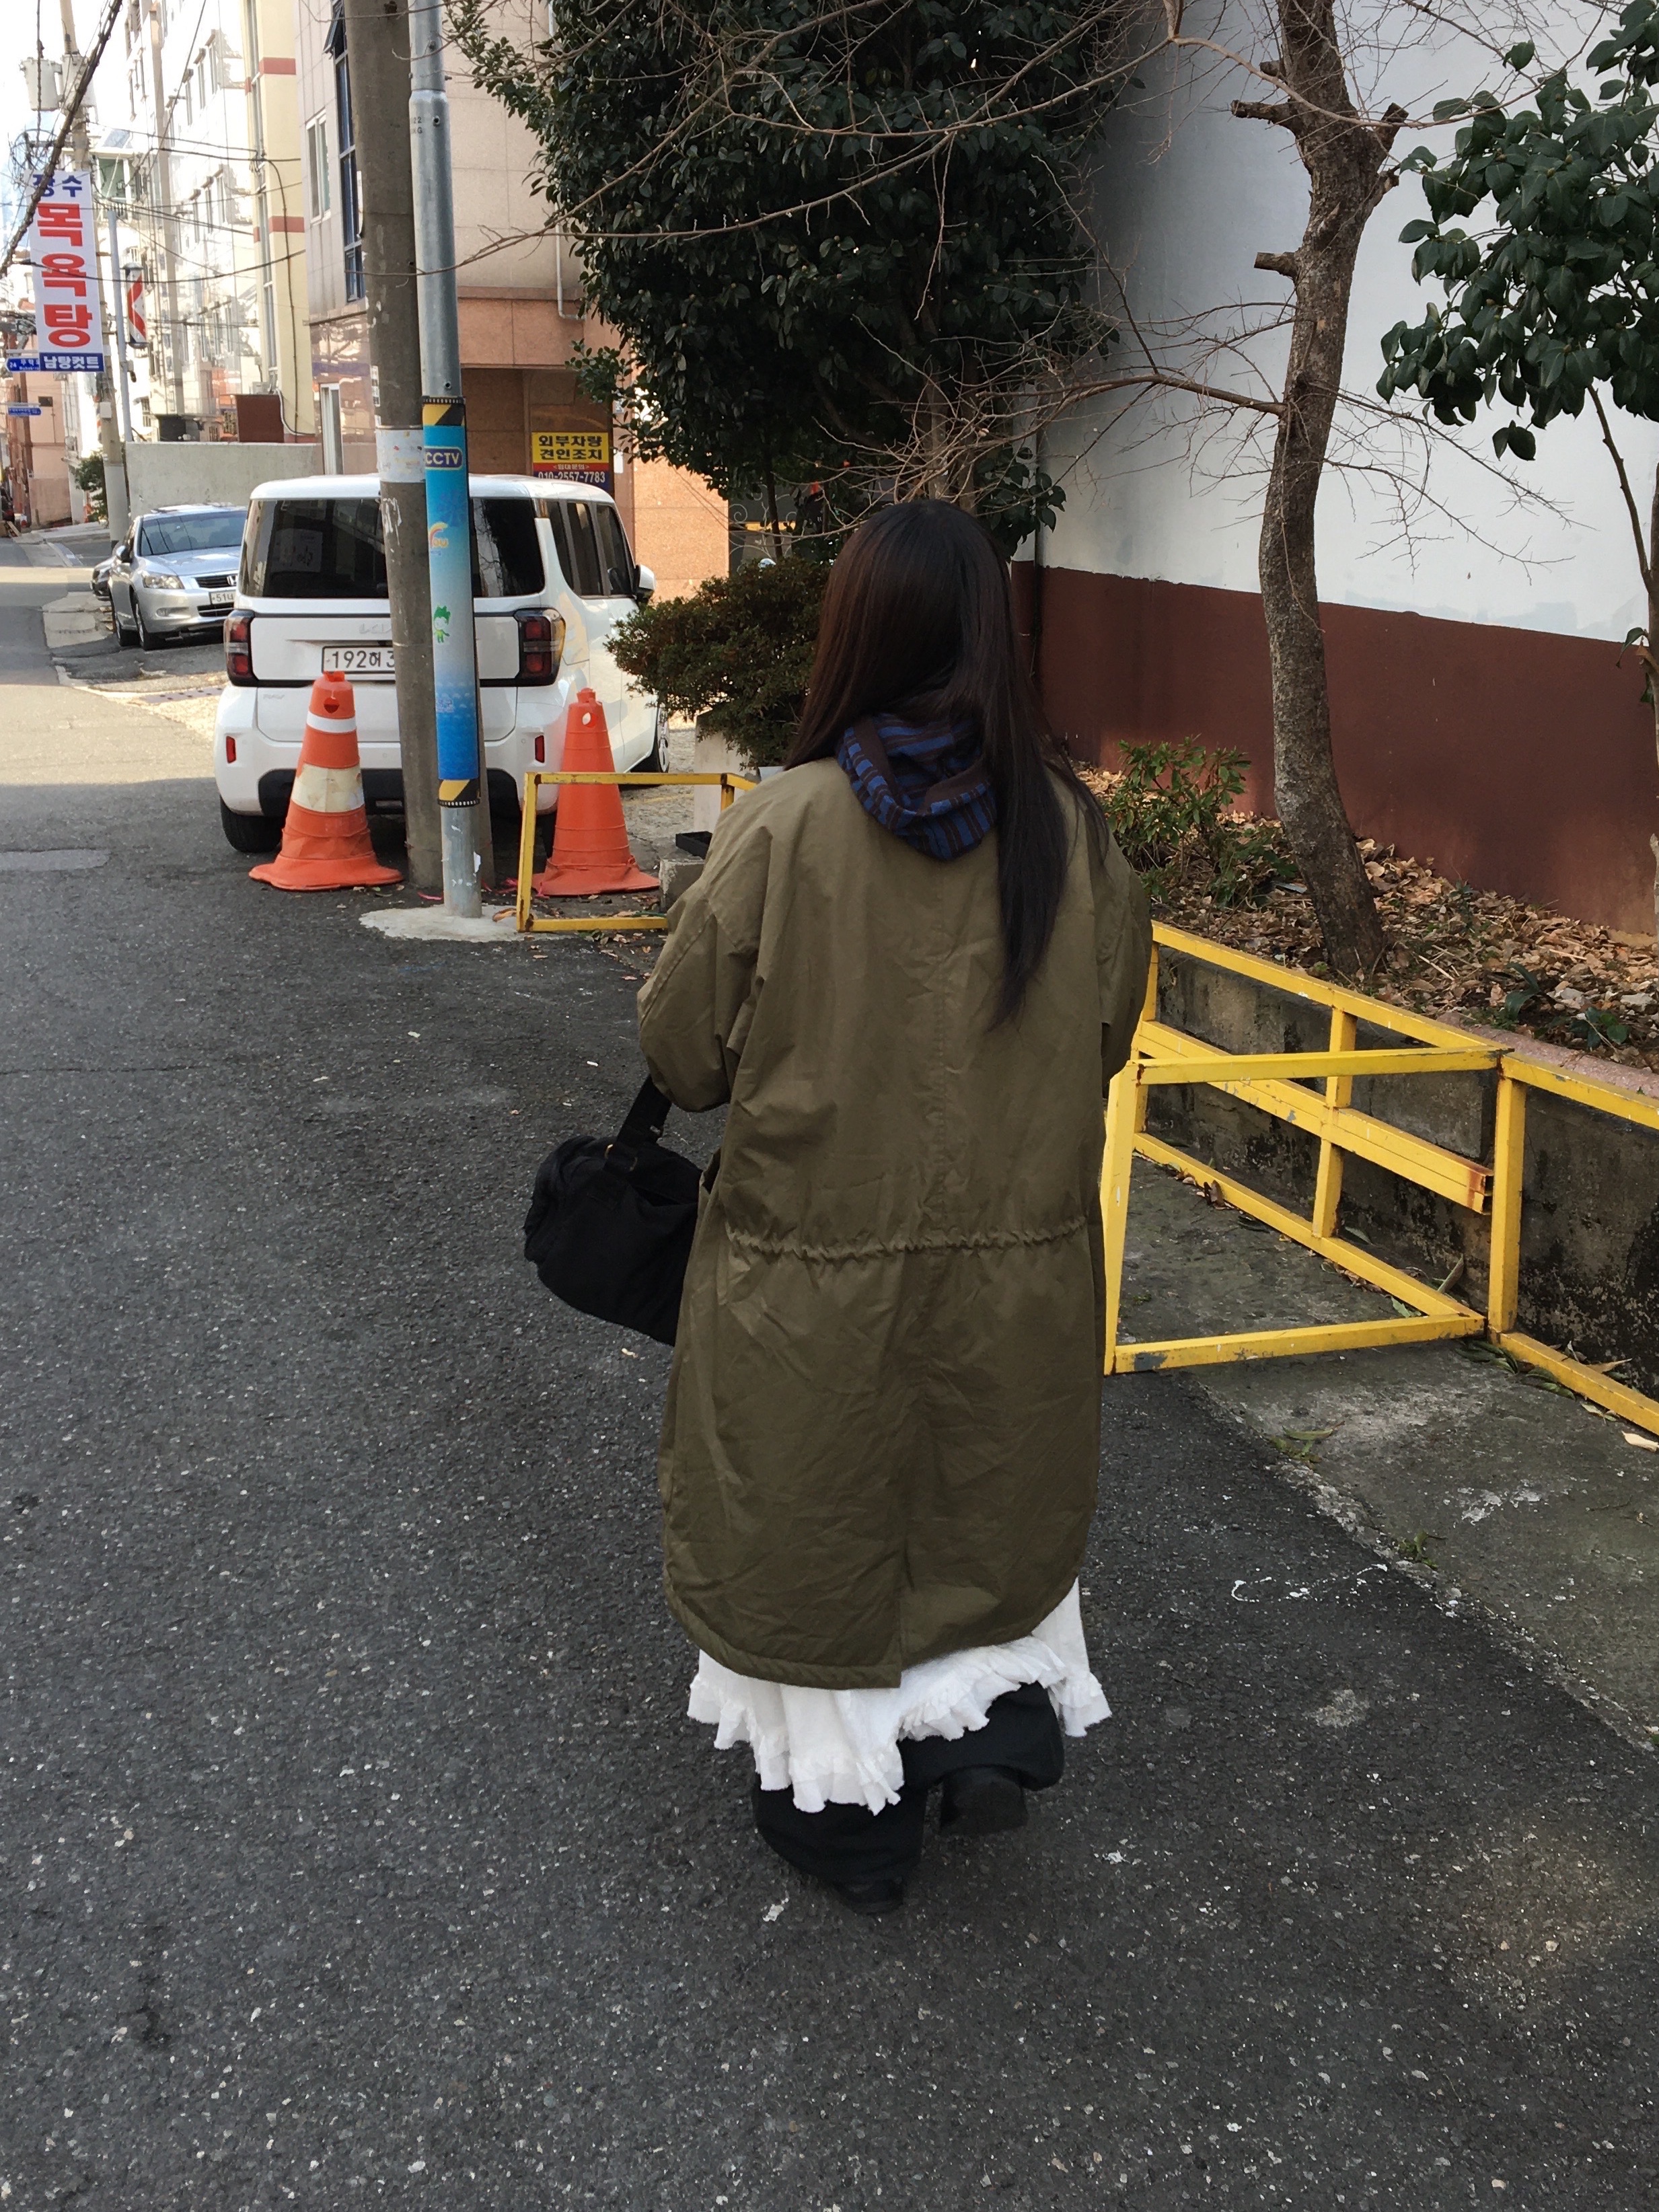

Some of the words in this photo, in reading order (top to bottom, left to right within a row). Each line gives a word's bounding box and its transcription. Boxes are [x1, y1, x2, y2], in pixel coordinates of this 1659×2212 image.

[32, 174, 82, 197] 장수
[37, 203, 93, 348] 목욕탕
[43, 356, 100, 369] 남탕컷트
[538, 435, 603, 447] 외부차량
[425, 451, 460, 466] CCTV
[540, 449, 602, 460] 견인조치
[538, 472, 605, 483] 010-2557-7783
